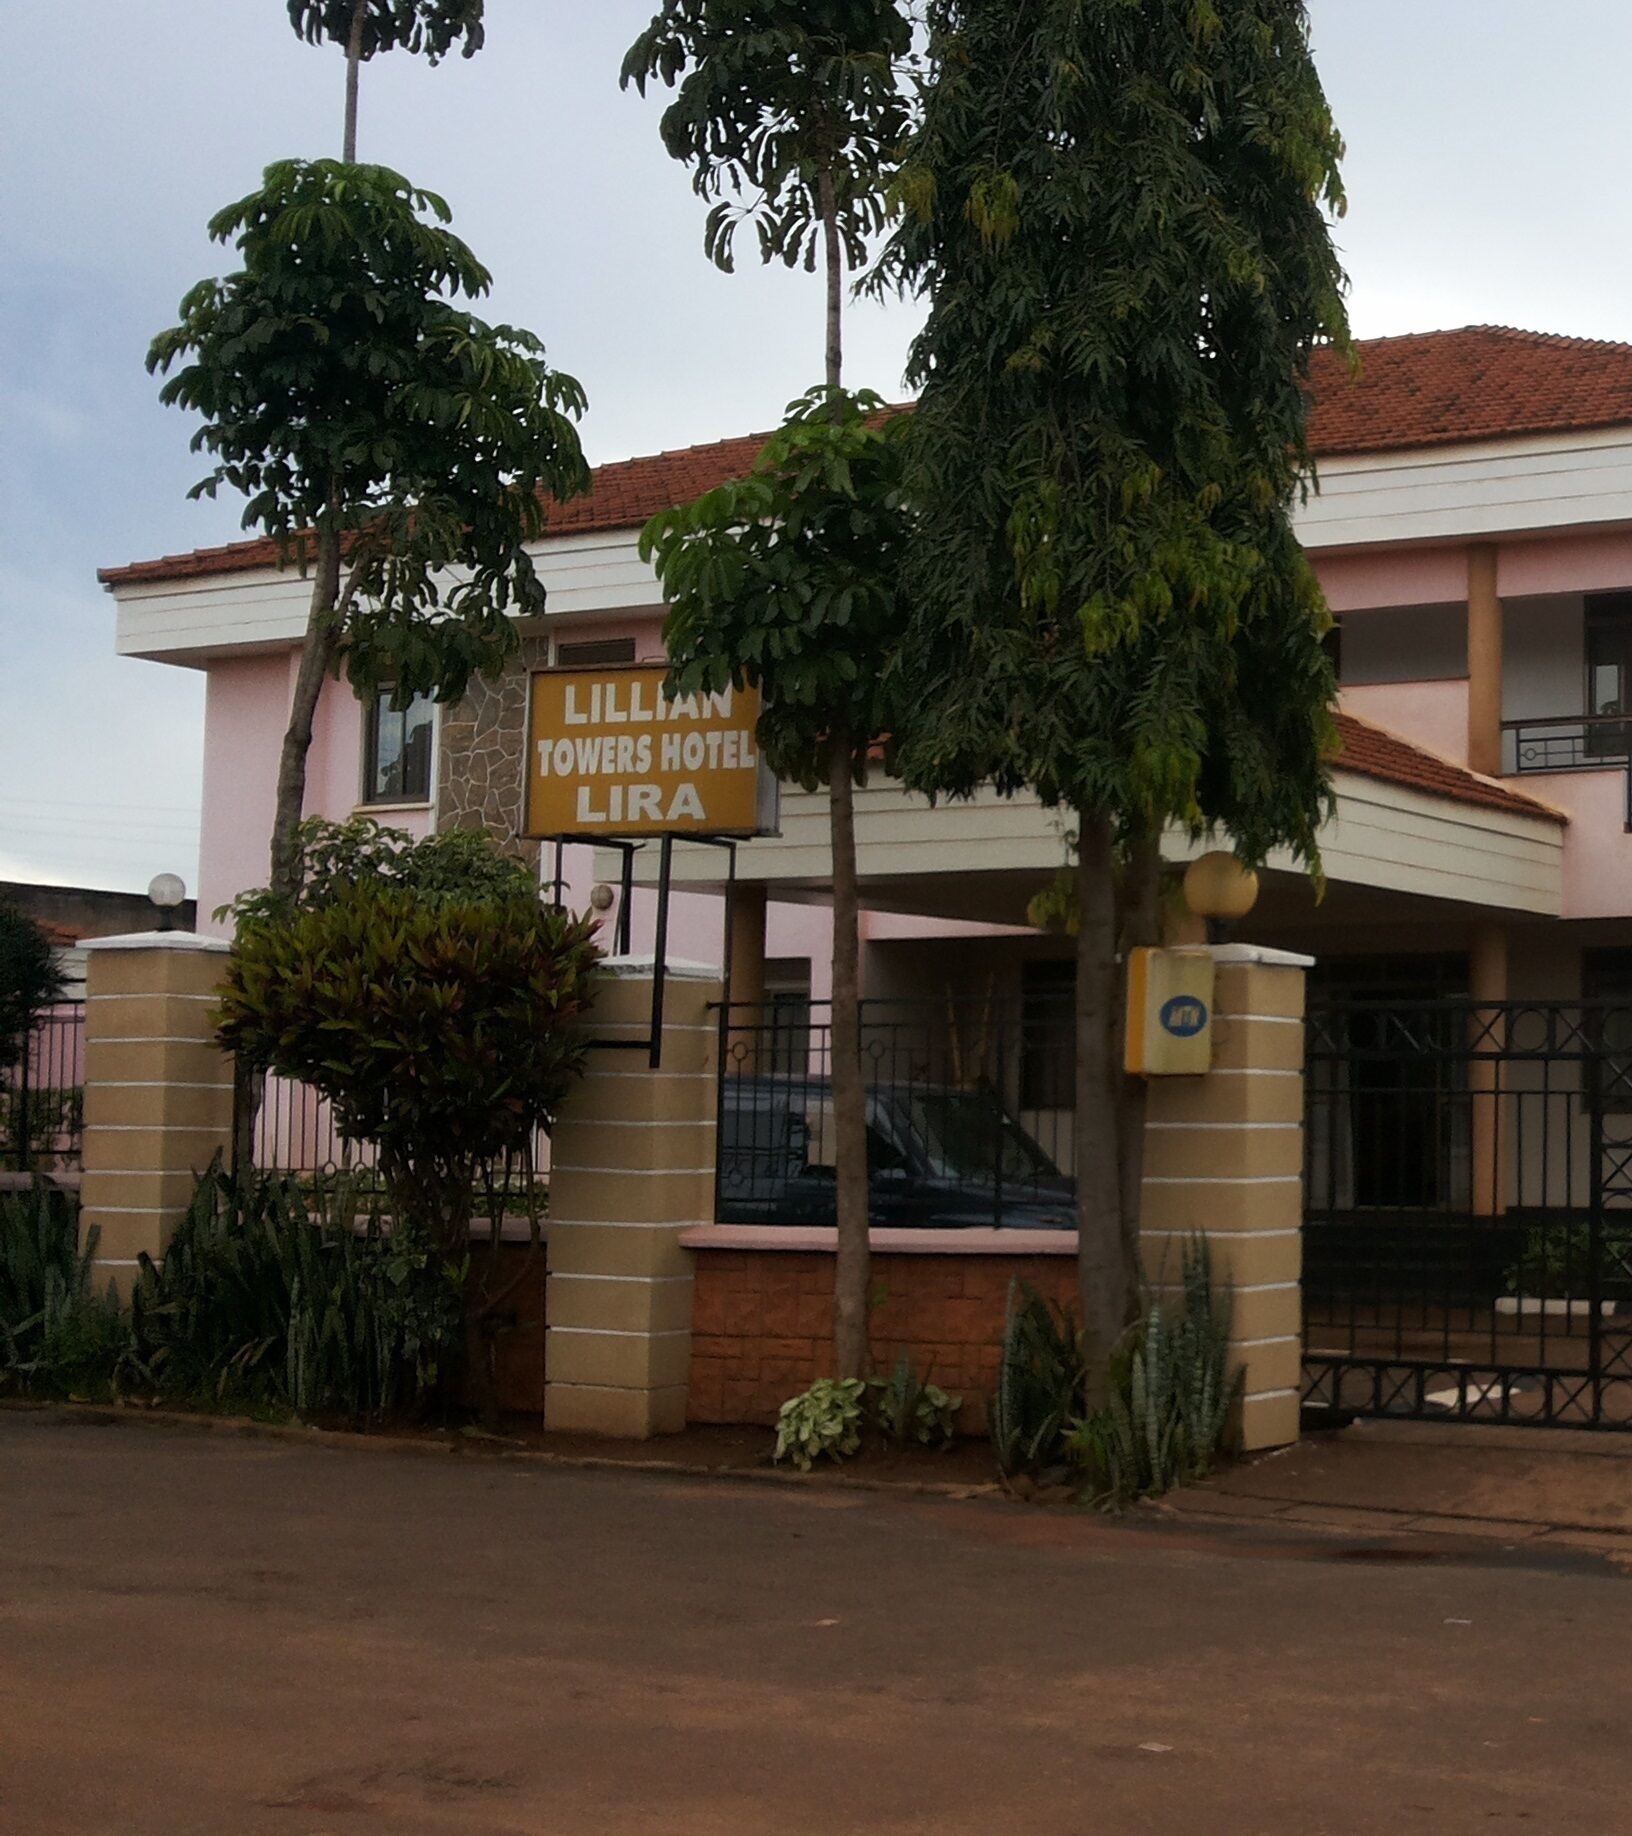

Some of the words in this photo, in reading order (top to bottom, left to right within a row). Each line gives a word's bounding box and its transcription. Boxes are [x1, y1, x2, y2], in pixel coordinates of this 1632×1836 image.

[565, 678, 733, 725] LILLIAN
[538, 734, 652, 777] TOWERS
[661, 730, 755, 772] HOTEL
[576, 783, 706, 823] LIRA
